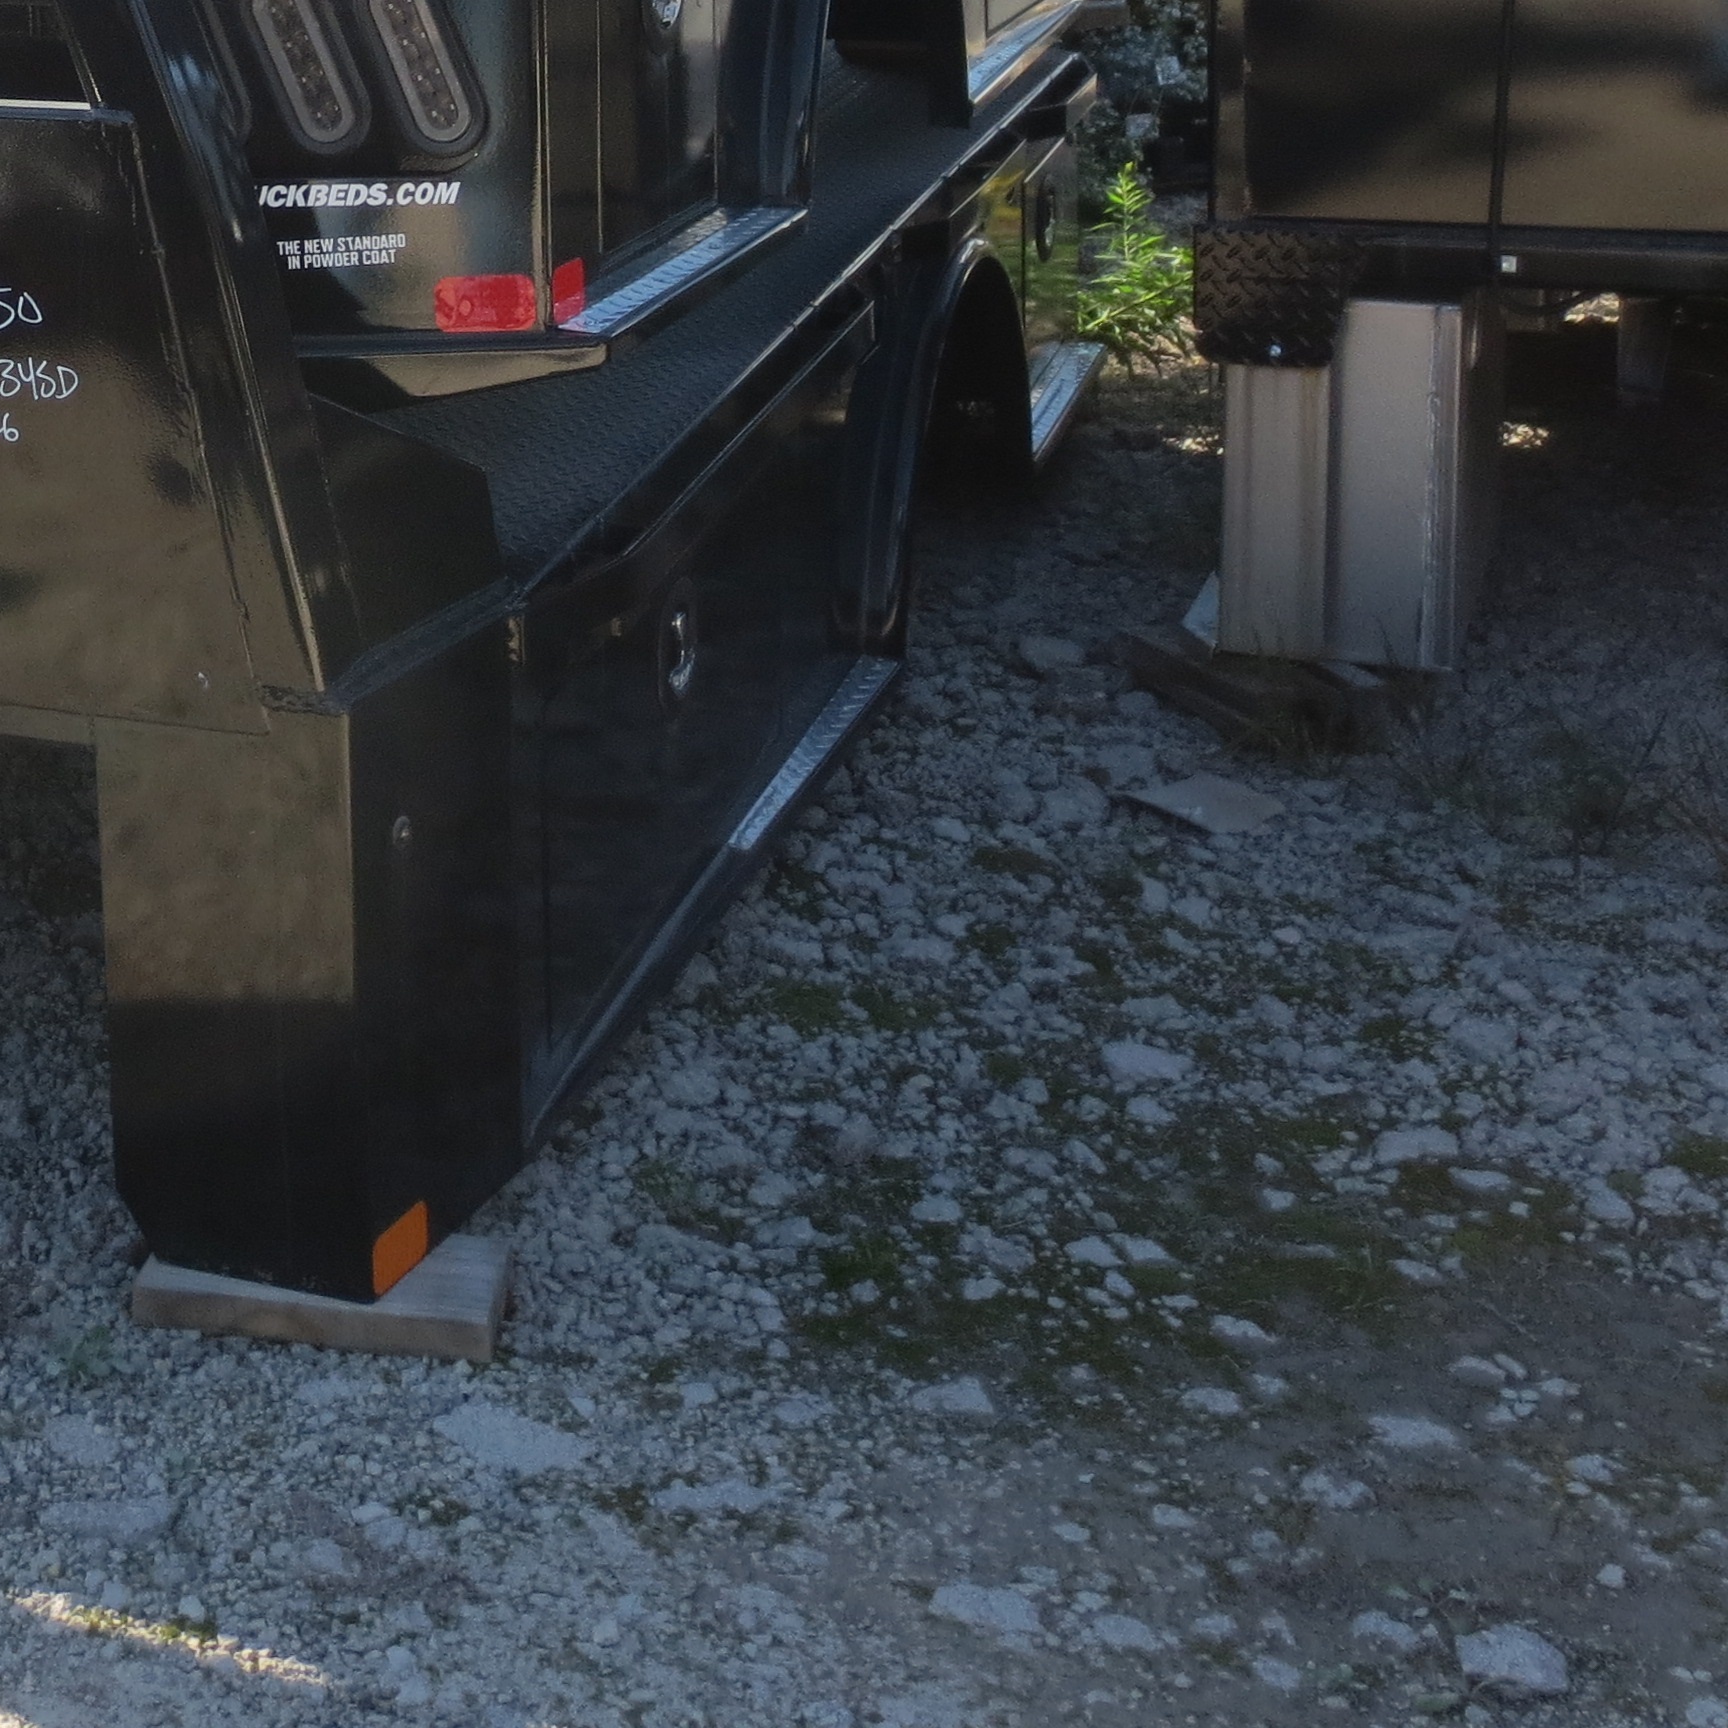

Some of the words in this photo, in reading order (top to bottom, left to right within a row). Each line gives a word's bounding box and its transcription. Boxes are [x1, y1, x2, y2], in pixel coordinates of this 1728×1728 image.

[277, 240, 301, 256] THE
[304, 238, 334, 254] NEW
[337, 233, 406, 253] STANDARD
[287, 255, 301, 270] IN
[304, 251, 360, 270] POWDER
[362, 249, 397, 265] COAT
